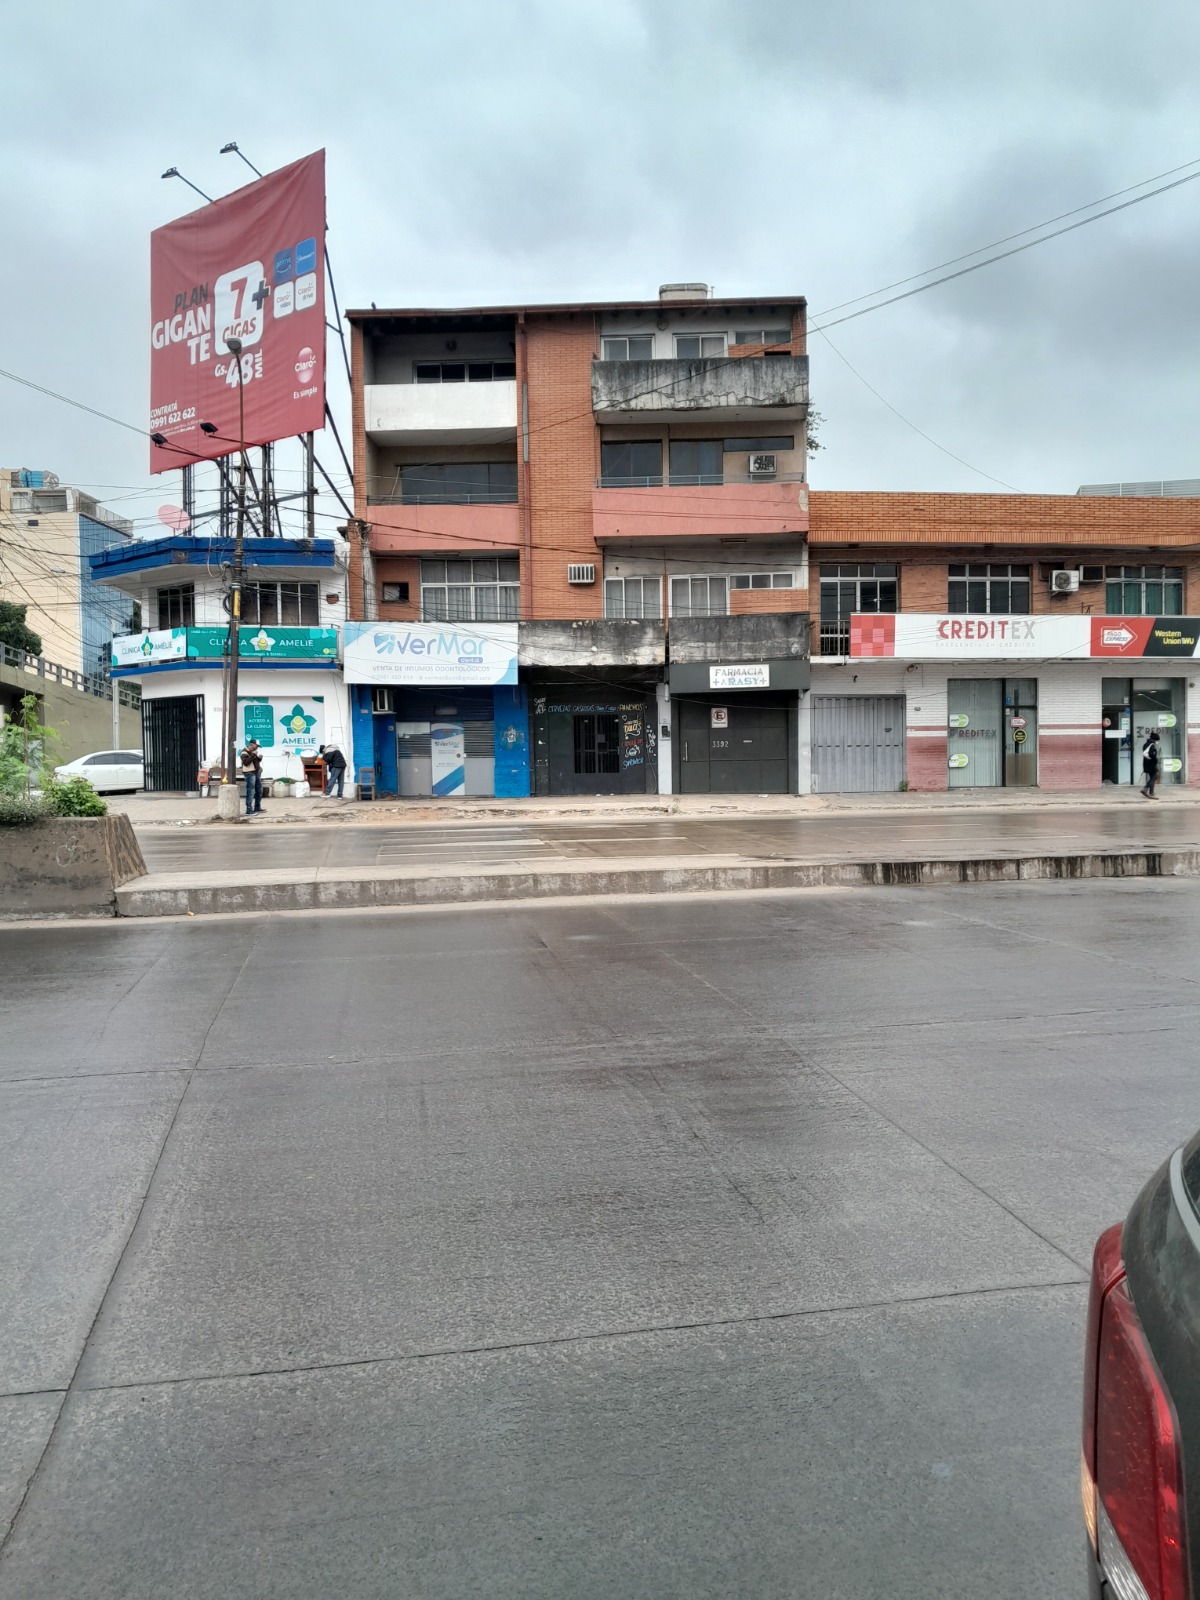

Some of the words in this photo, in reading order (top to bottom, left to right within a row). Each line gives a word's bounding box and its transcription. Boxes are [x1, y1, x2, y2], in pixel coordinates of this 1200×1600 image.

[174, 282, 209, 313] PLAN
[152, 303, 211, 349] GIGAN
[222, 317, 257, 343] GIGAS
[187, 332, 211, 366] TE
[225, 353, 254, 388] 48
[254, 348, 263, 378] MIL
[300, 386, 318, 397] simple
[150, 416, 167, 430] 0991
[168, 412, 181, 424] 622
[182, 406, 196, 420] 622
[938, 620, 1035, 639] CREDITEX
[278, 639, 315, 647] AMELIE
[396, 632, 488, 655] VerMar
[715, 668, 763, 676] FARMACIA
[721, 678, 759, 686] ARASY
[281, 737, 316, 745] AMELIE
